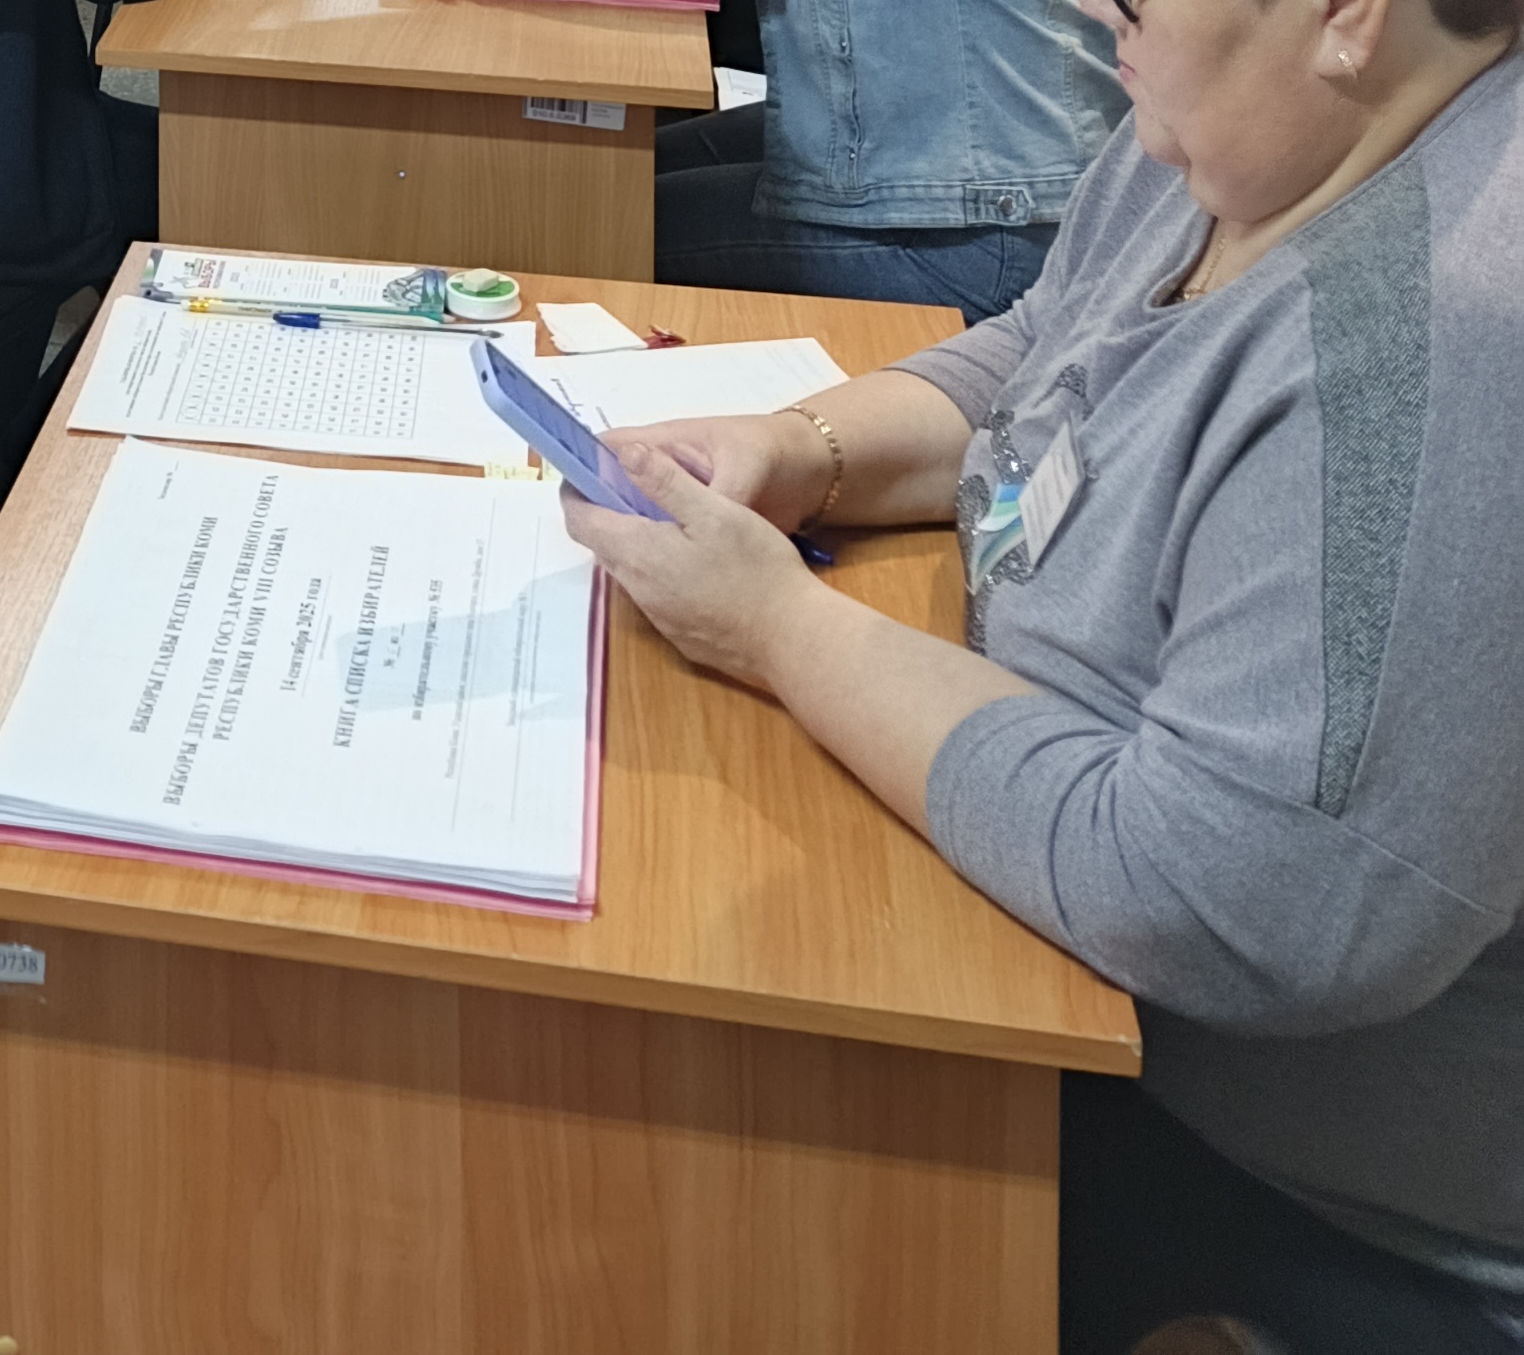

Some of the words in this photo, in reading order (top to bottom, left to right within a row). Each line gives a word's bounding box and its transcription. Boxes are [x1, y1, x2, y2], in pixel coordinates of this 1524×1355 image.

[306, 577, 322, 600] года
[357, 546, 389, 636] ИЗБИРАТЕЛЕЙ
[129, 678, 164, 733] ВЫБОРЫ
[150, 633, 180, 677] ГЛАВЫ
[167, 550, 206, 631] РЕСПУБЛИКИ
[194, 516, 218, 549] КОМИ
[163, 741, 198, 805] ВЫБОРЫ
[185, 658, 225, 738] ДЕПУТАТОВ
[212, 520, 264, 654] ГОСУДАРСТВЕННОГО
[253, 475, 279, 518] СОВЕТА
[213, 650, 254, 741] РЕСПУБЛИКИ
[241, 606, 267, 646] КОМИ
[261, 527, 288, 575] СОЗЫВА
[296, 602, 316, 628] 2025
[288, 630, 312, 679] сентября
[344, 640, 371, 695] СПИСКА
[279, 679, 297, 691] 14
[333, 699, 360, 748] КНИГА
